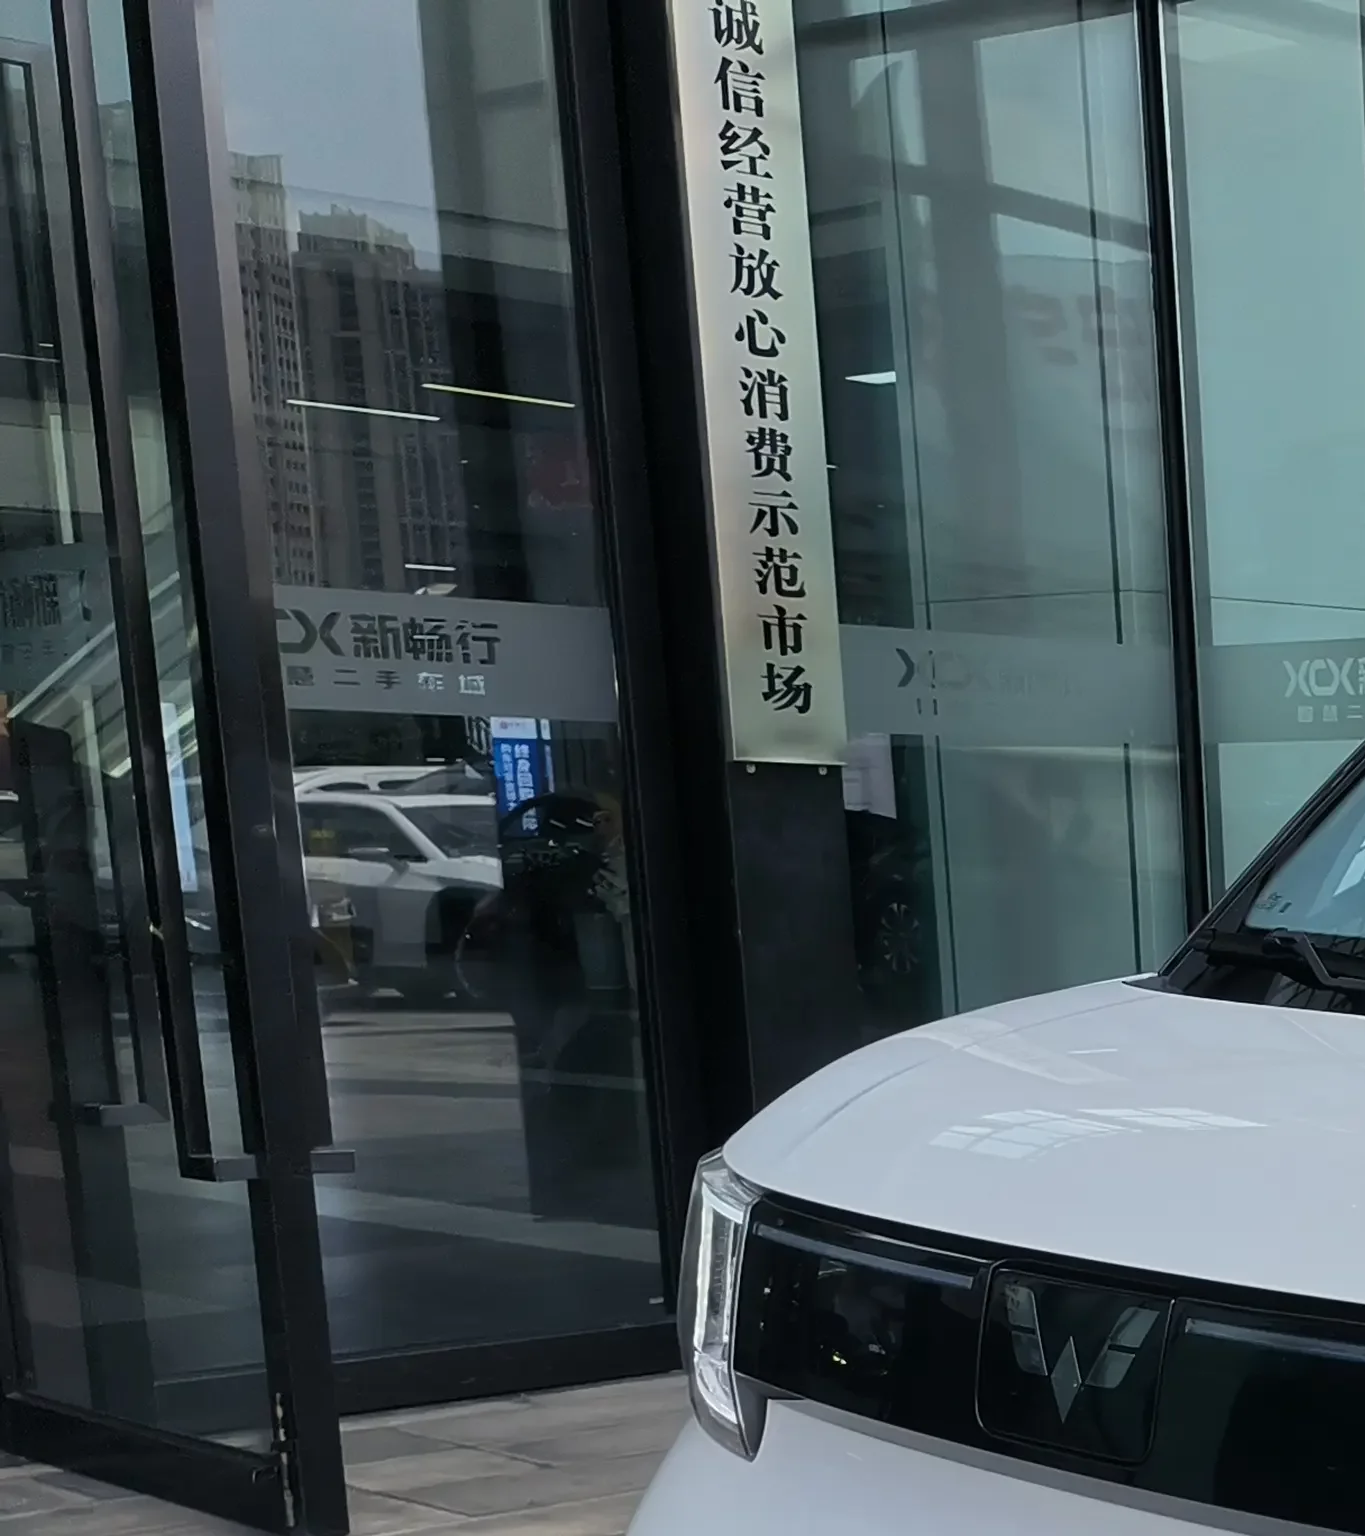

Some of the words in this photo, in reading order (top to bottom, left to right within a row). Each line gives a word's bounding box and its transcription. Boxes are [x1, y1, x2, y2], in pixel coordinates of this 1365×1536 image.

[707, 0, 814, 715] 诚信经营放心消费示范市场
[349, 613, 501, 665] 新畅行
